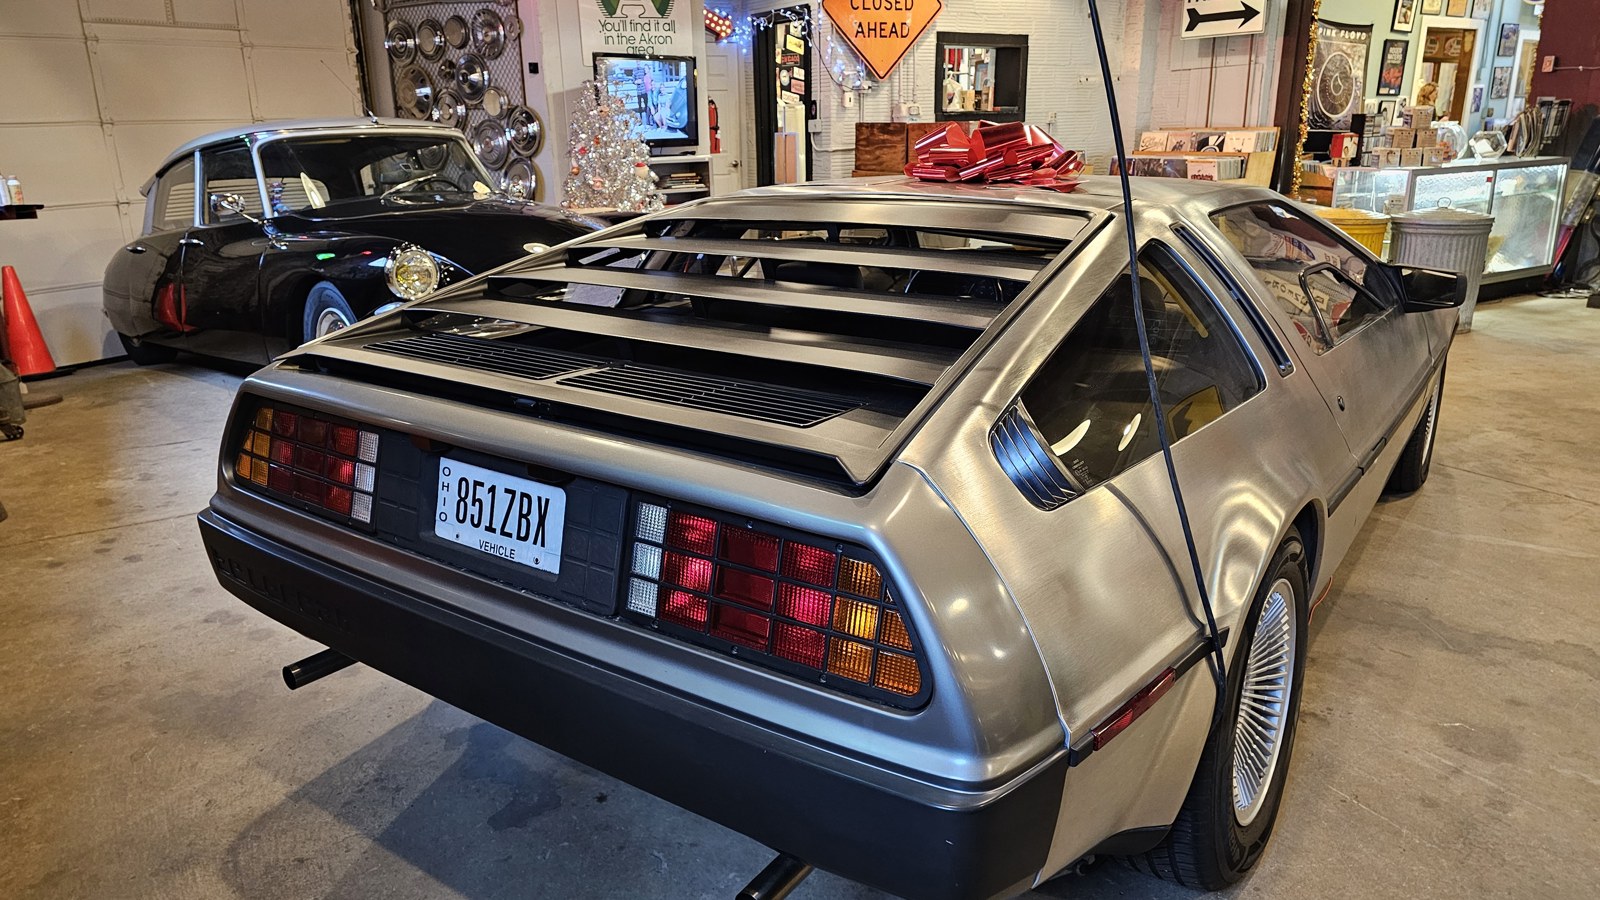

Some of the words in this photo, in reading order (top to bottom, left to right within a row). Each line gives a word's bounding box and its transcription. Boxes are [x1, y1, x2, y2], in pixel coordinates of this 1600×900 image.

[850, 0, 914, 11] CLOSED
[598, 19, 627, 32] You'll
[629, 19, 651, 32] find
[653, 20, 660, 32] it
[662, 20, 676, 33] all
[854, 21, 910, 39] AHEAD
[604, 32, 615, 45] in
[617, 32, 636, 45] the
[638, 32, 673, 45] Akron
[1318, 27, 1337, 37] PINK
[1340, 30, 1367, 40] FLOYD
[626, 45, 655, 55] area
[455, 476, 550, 549] 851ZBX
[478, 539, 516, 560] VEHICLE
